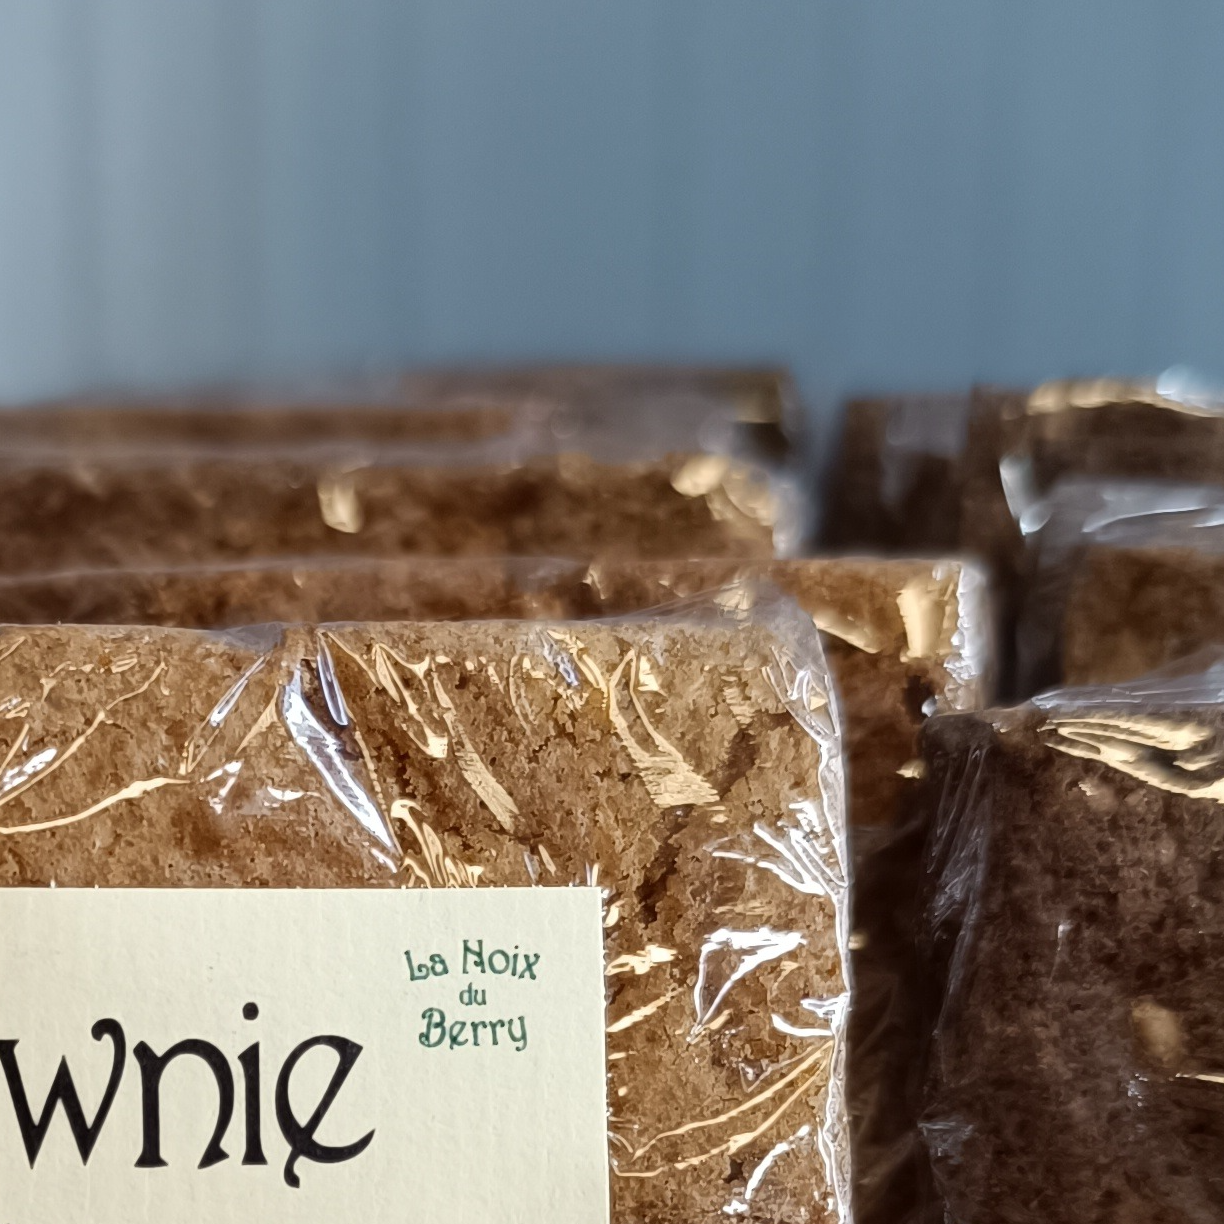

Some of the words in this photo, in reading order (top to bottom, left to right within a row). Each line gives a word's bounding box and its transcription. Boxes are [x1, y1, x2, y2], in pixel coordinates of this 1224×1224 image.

[404, 949, 449, 981] La
[462, 939, 540, 981] Noix
[459, 982, 487, 1006] du
[418, 1007, 528, 1052] Berry
